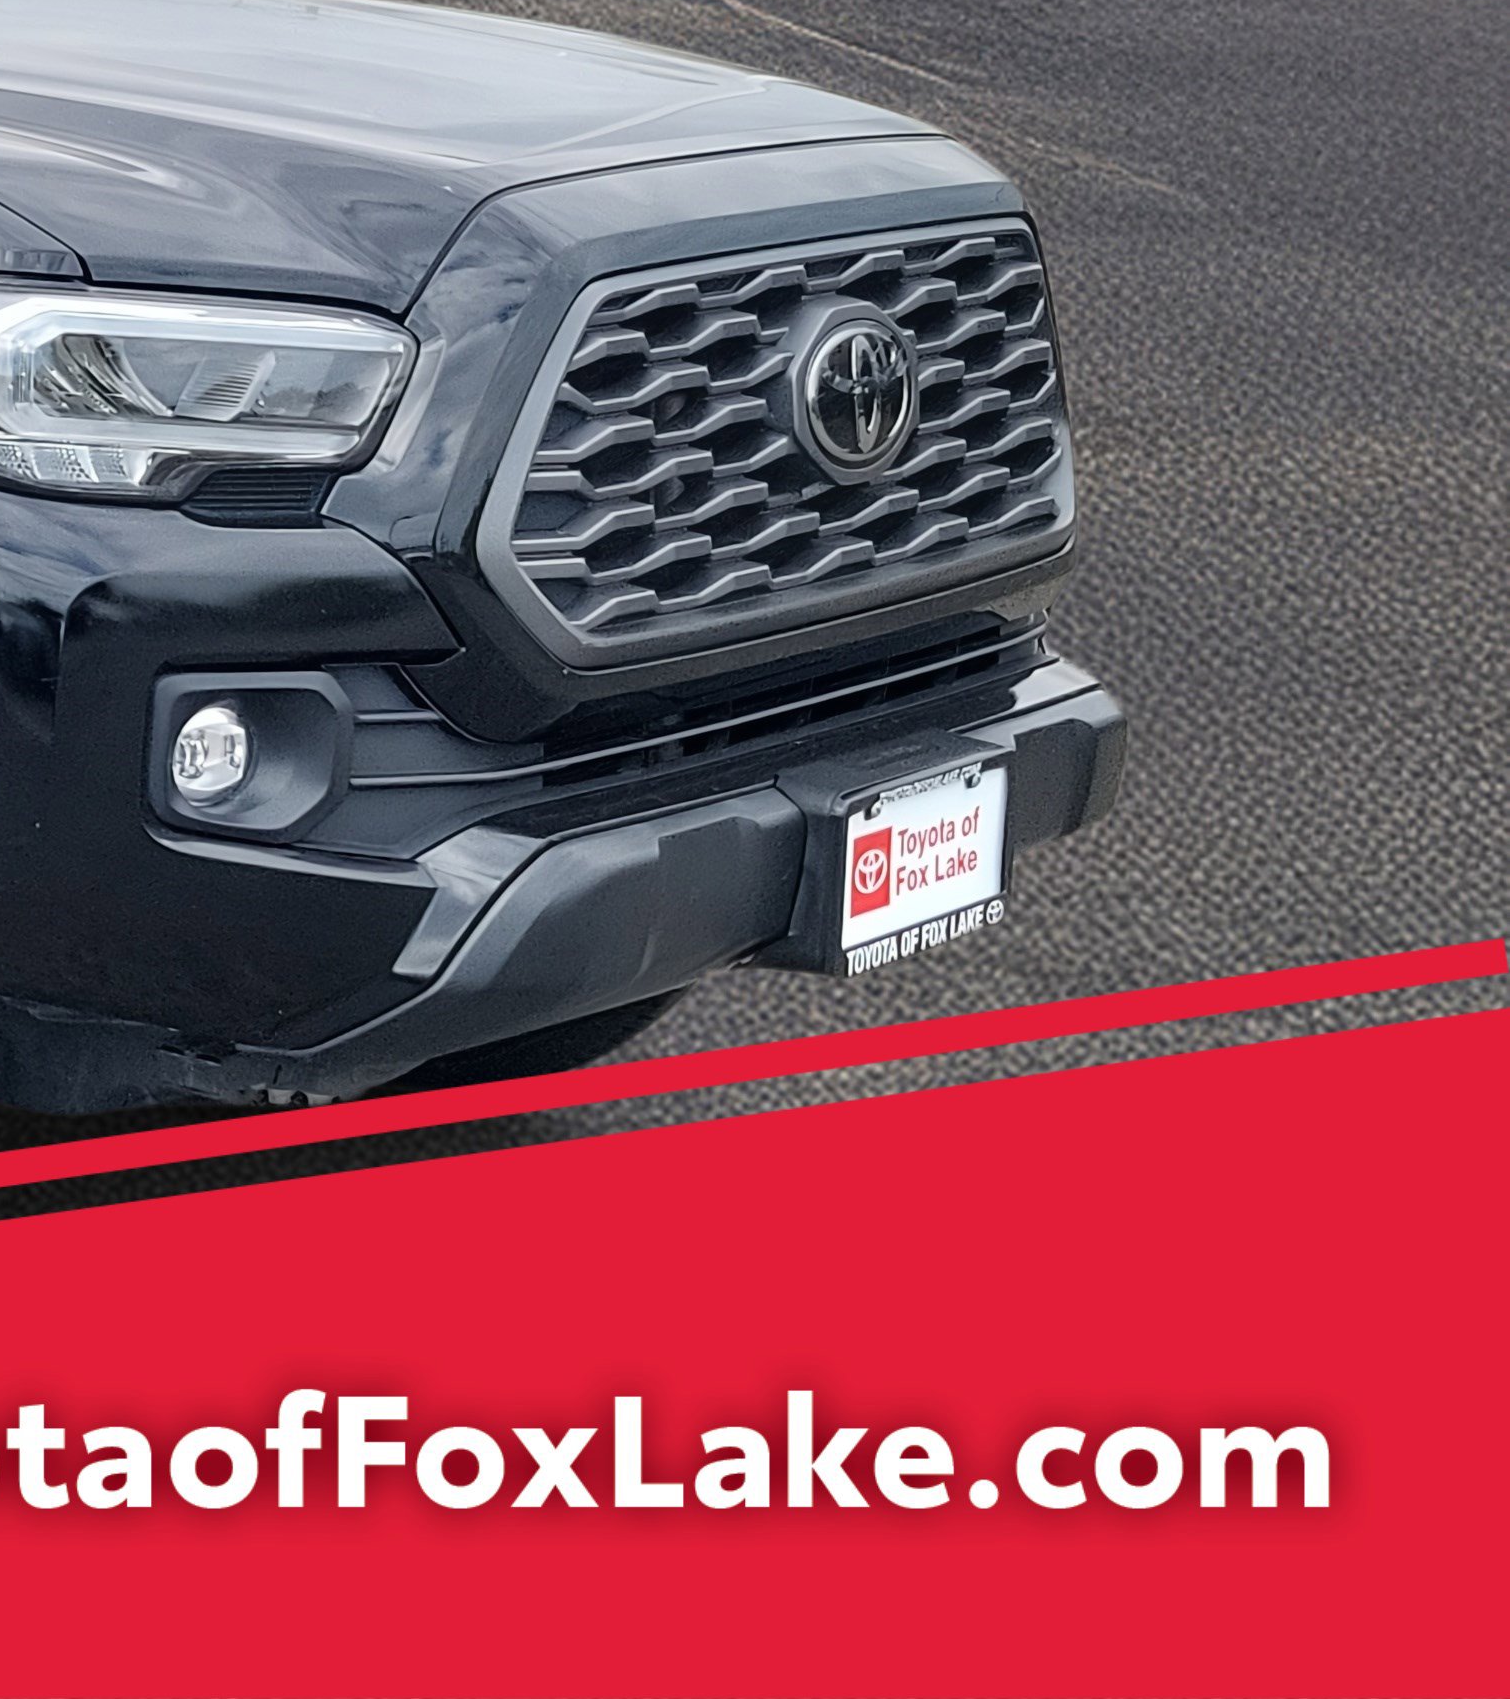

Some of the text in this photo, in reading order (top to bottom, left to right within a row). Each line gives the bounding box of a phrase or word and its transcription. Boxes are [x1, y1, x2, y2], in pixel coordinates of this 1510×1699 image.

[897, 807, 980, 858] Toyota of
[896, 848, 977, 896] Fox Lake
[847, 903, 984, 977] TOYOTA OF FOX LAKE
